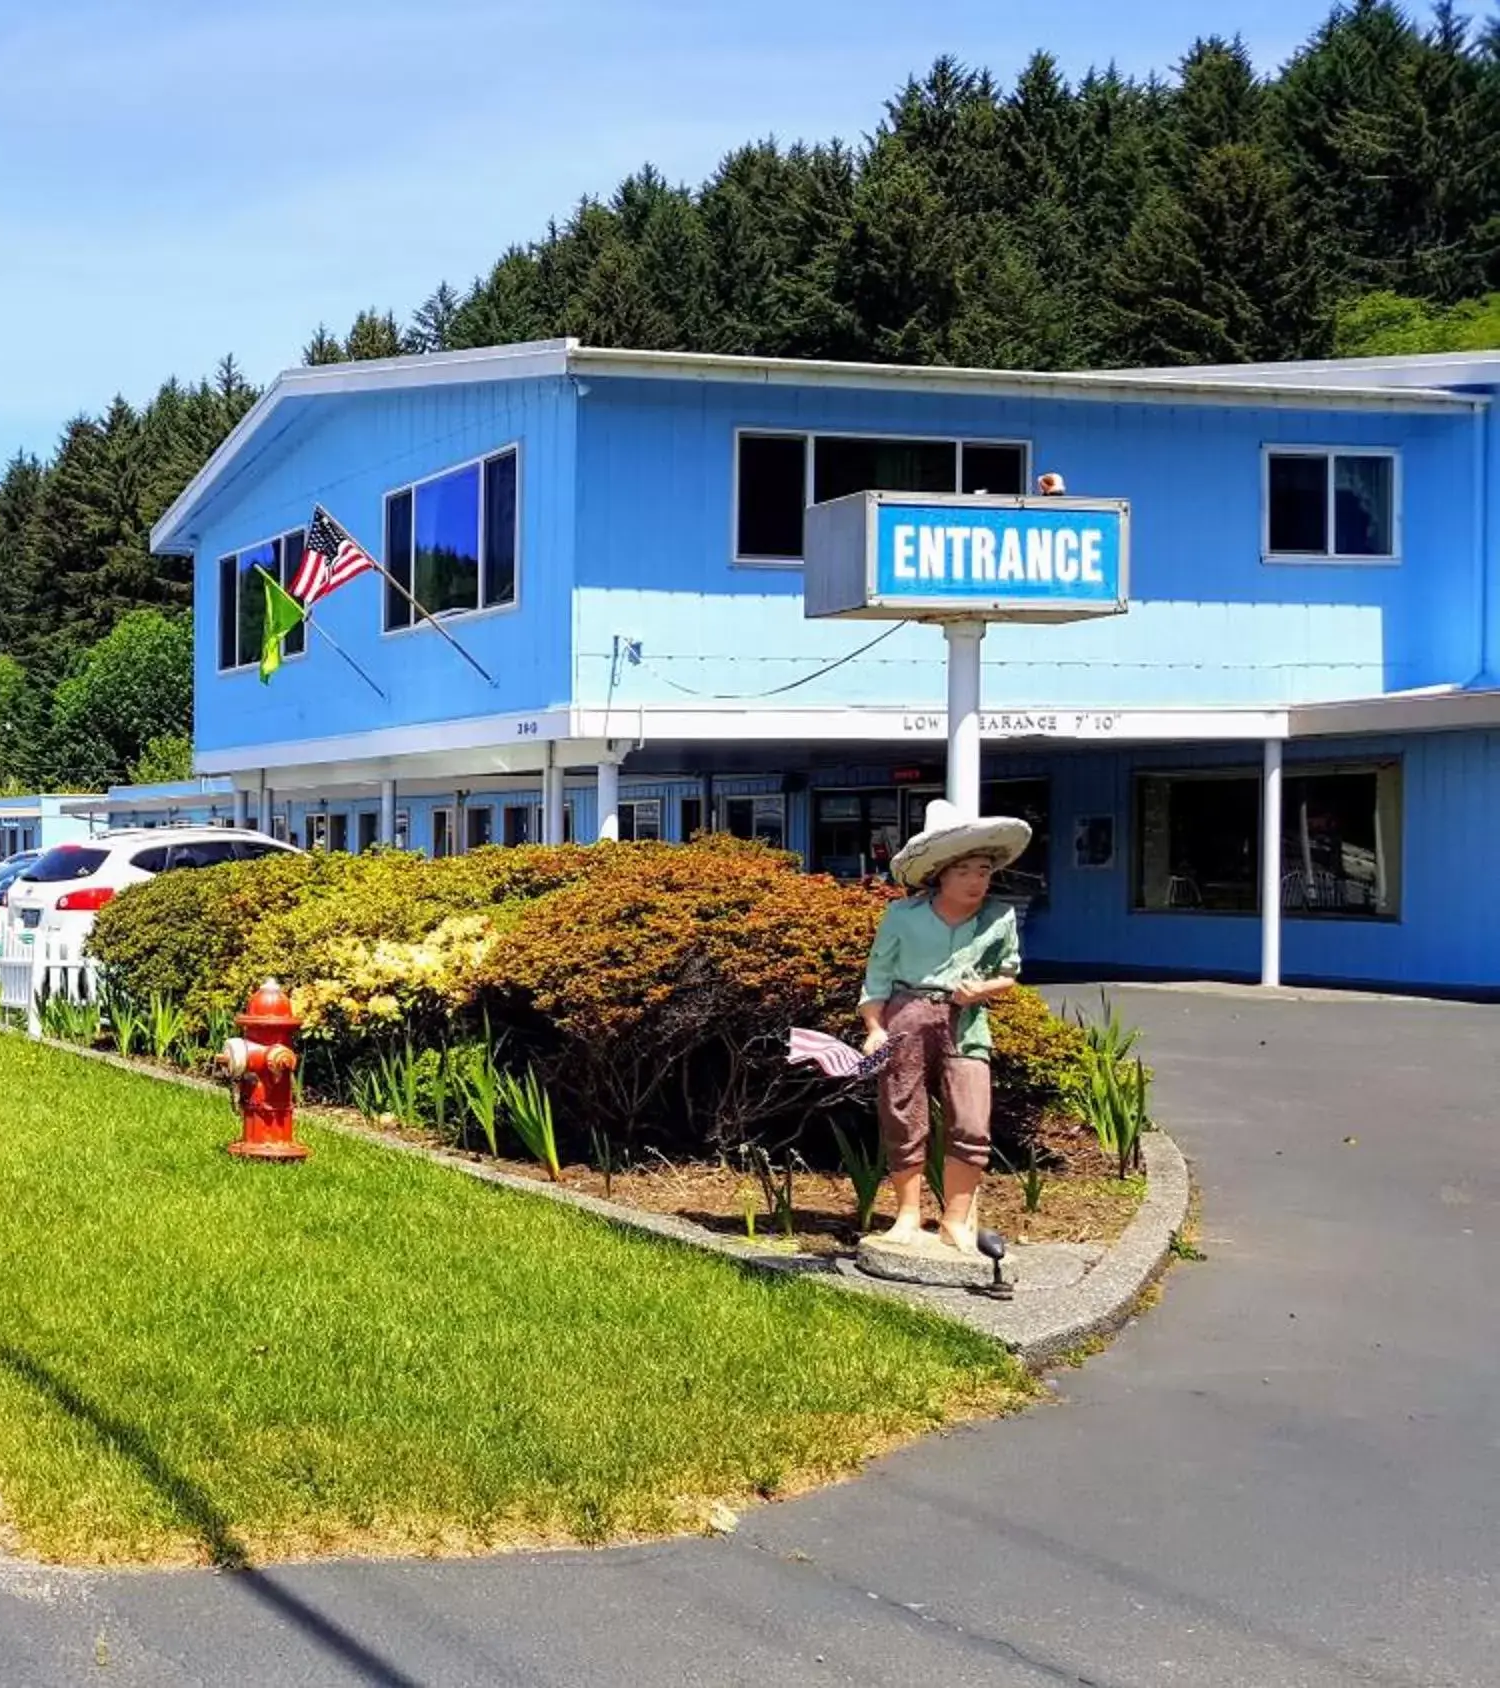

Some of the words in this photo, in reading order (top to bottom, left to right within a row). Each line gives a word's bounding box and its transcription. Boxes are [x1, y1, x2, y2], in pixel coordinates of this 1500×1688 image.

[893, 524, 1103, 582] ENTRANCE
[903, 716, 940, 730] LOW
[979, 714, 1057, 731] EARANCE
